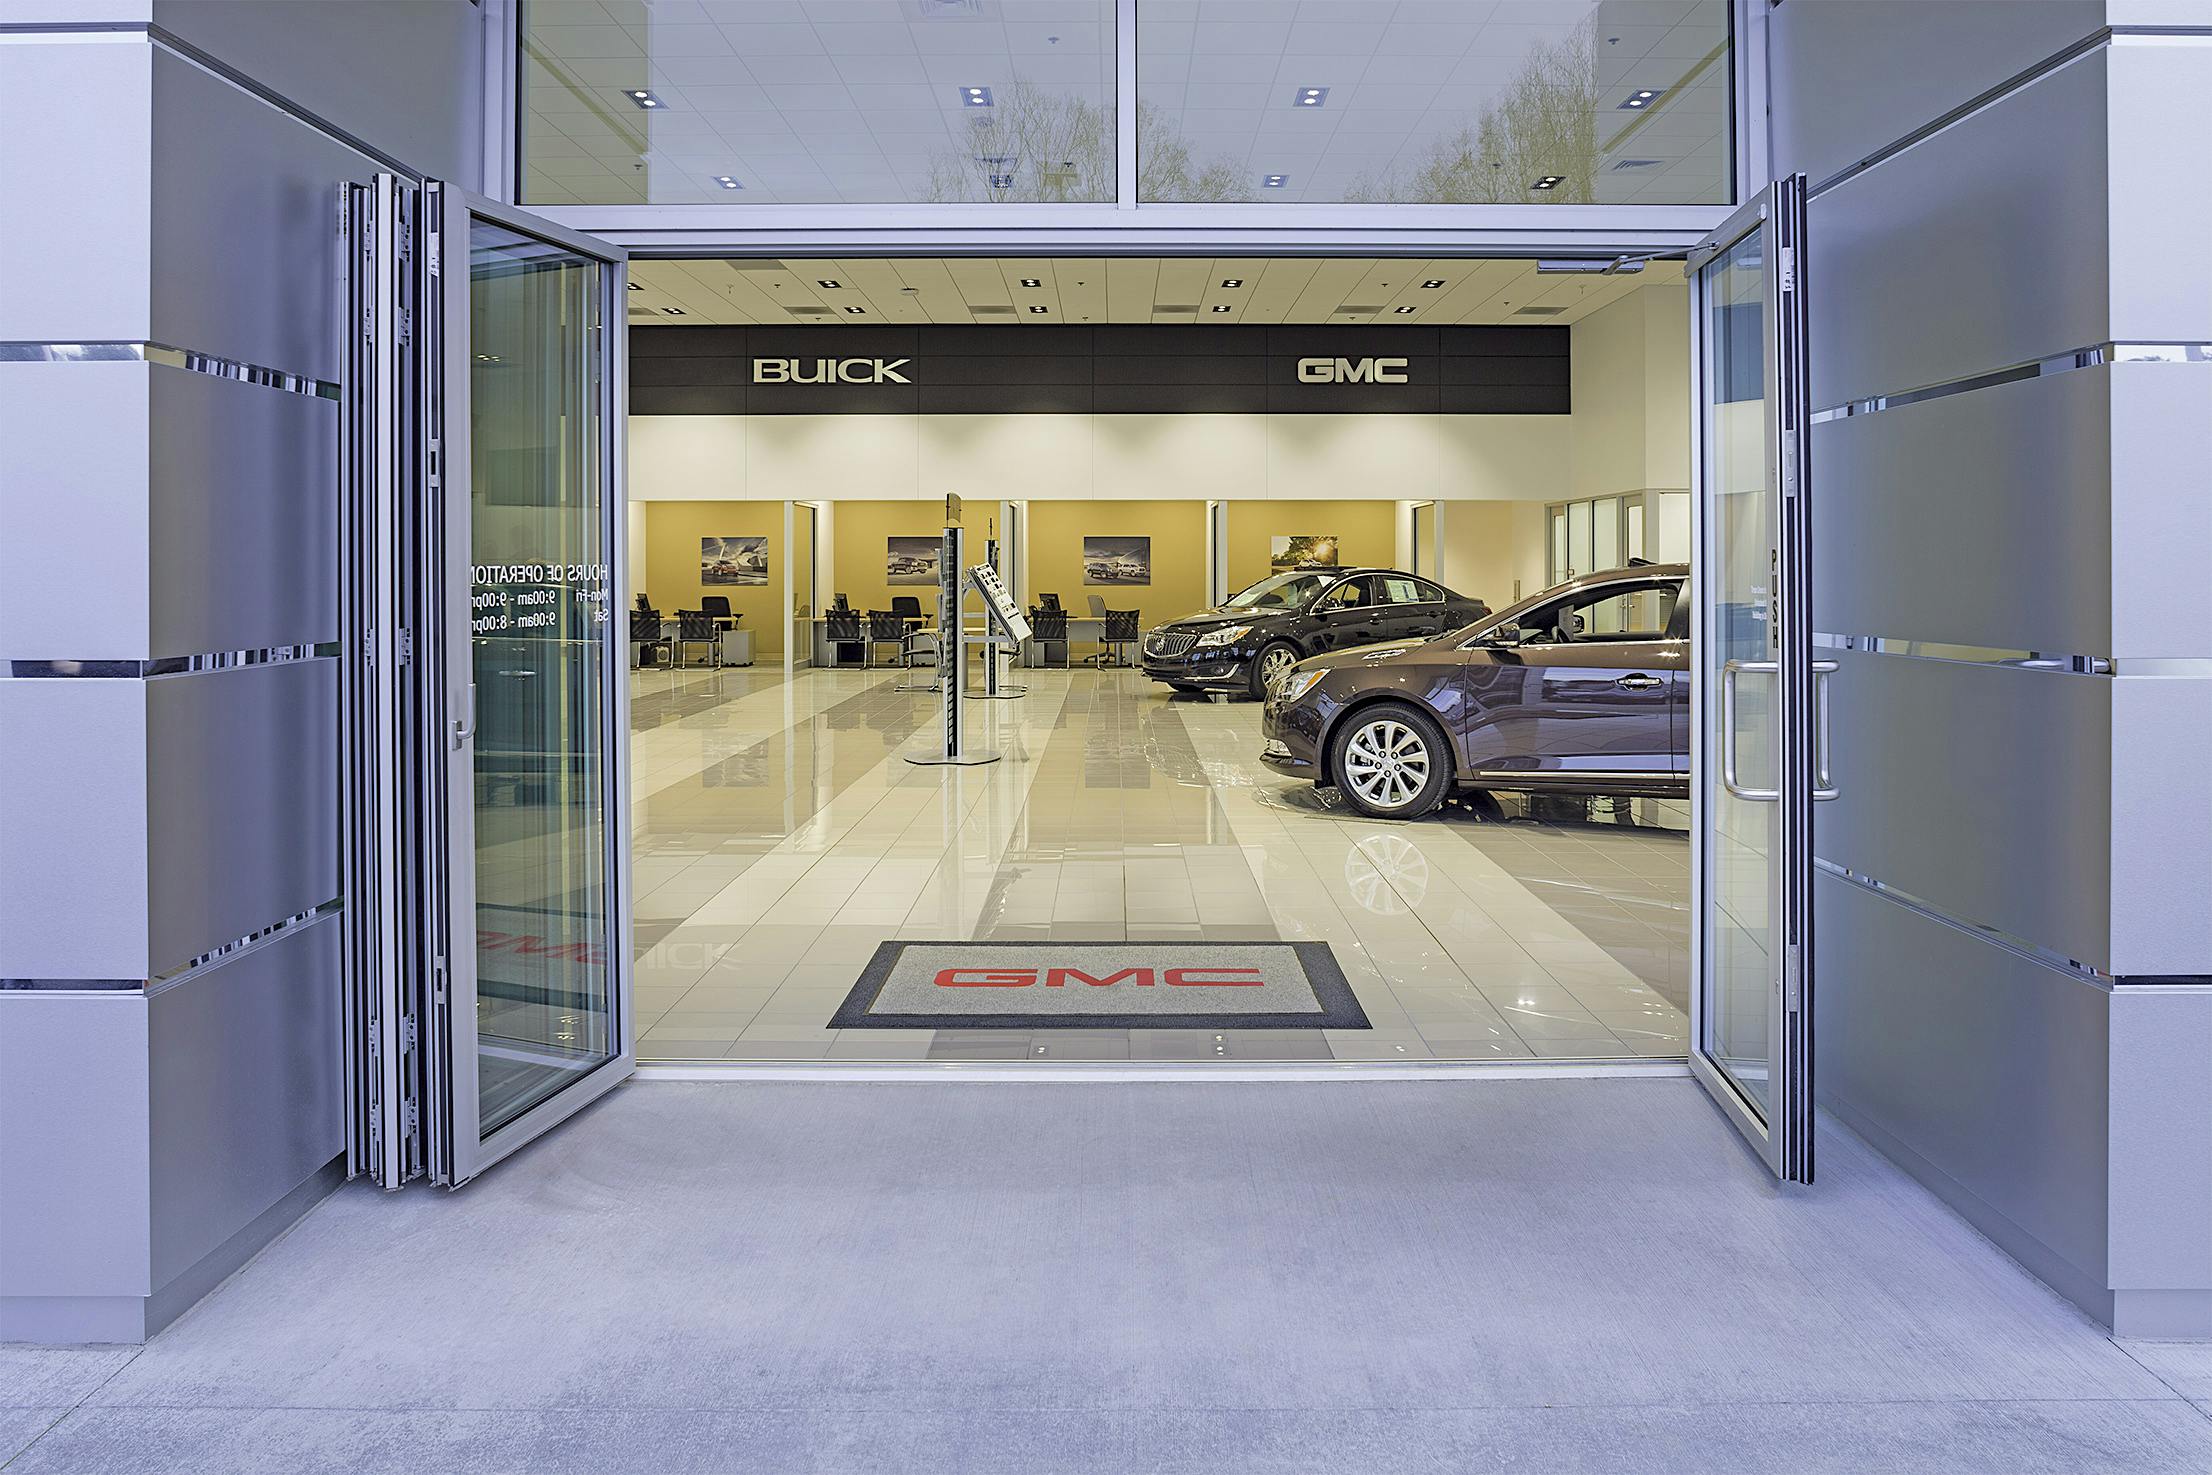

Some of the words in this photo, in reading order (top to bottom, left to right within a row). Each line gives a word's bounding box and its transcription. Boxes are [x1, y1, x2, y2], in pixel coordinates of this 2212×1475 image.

[753, 358, 912, 384] BUICK
[1297, 358, 1408, 384] GMC
[933, 968, 1265, 988] GMC
